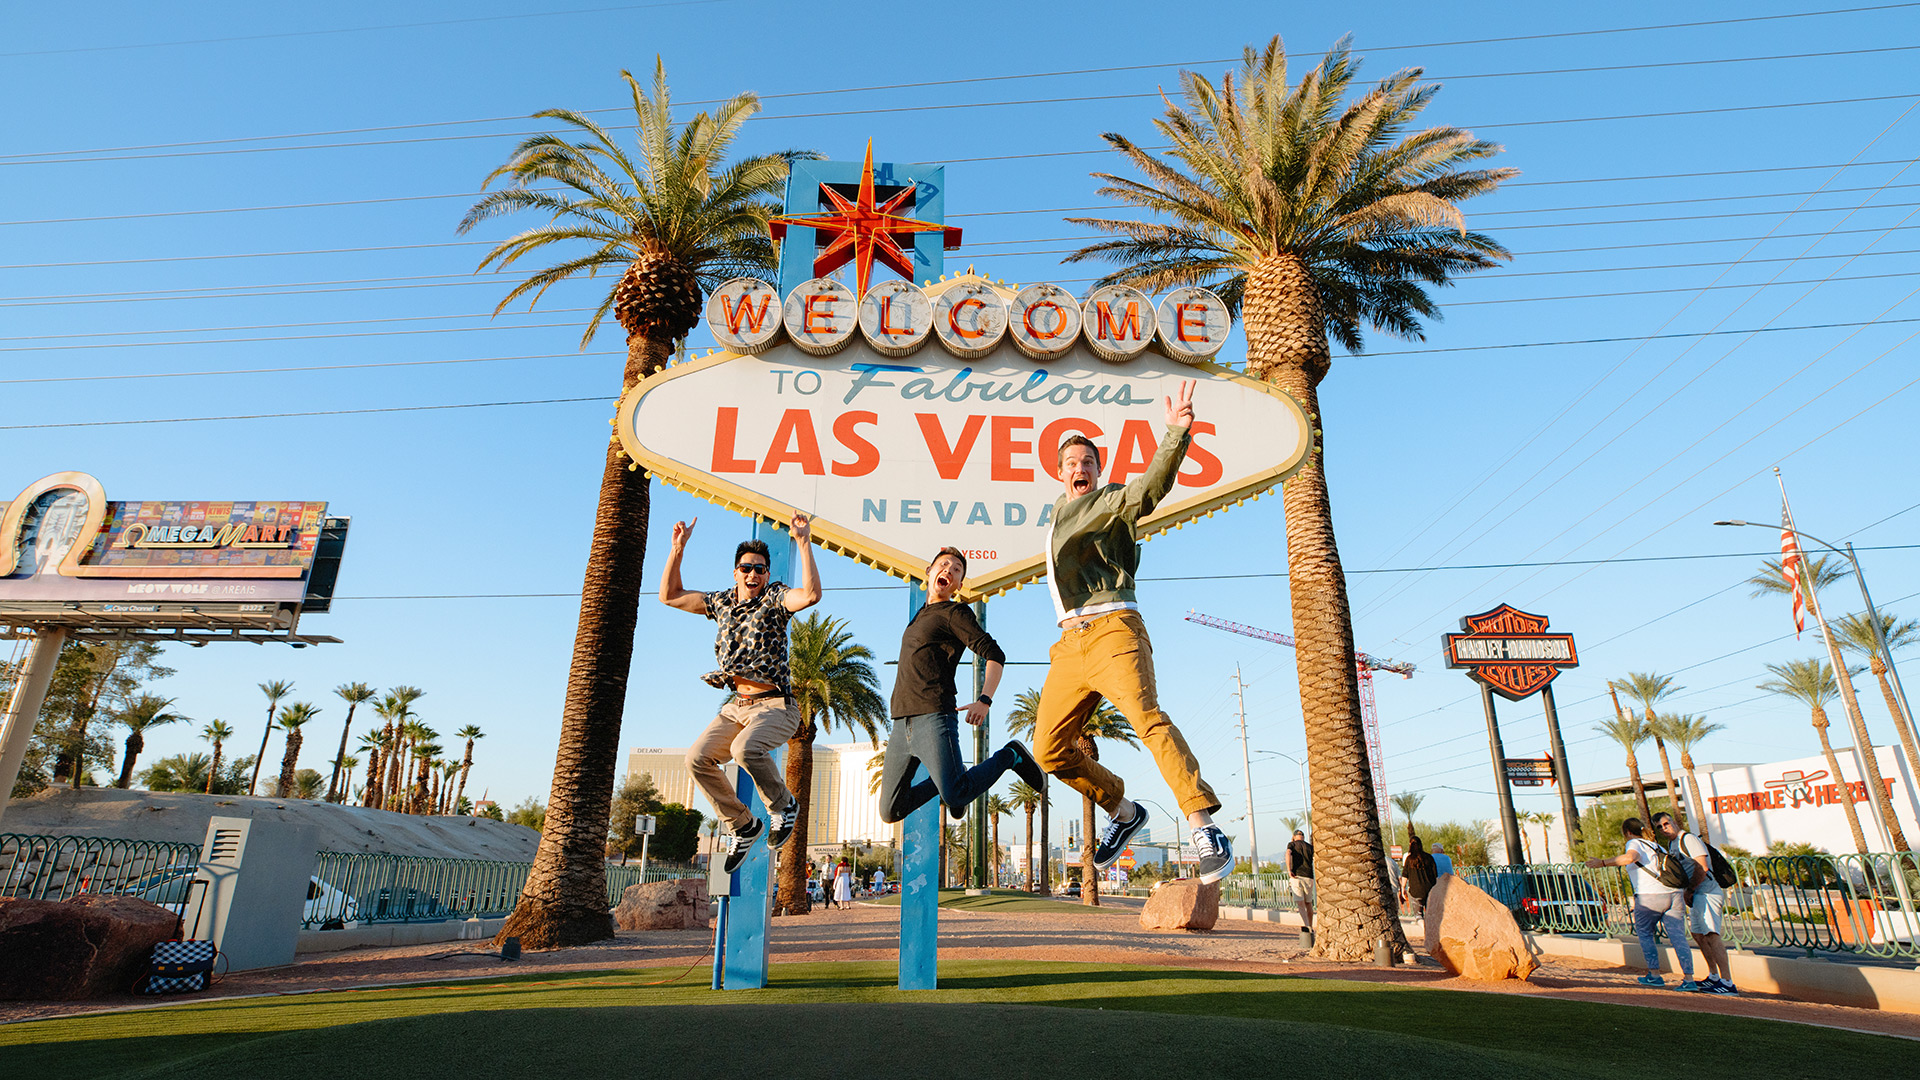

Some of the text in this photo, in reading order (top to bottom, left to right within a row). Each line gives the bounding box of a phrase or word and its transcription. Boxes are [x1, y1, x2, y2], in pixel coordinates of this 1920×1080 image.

[721, 293, 1209, 342] WELCOME
[770, 362, 1155, 406] TO Fabulous
[710, 407, 1224, 488] LAS VEGAS
[962, 549, 998, 560] YESCO
[127, 584, 169, 594] MEOW
[170, 584, 208, 594] WOLF
[1478, 611, 1540, 633] MOTOR
[1455, 639, 1572, 660] HARLEY-DAVIDSON
[1486, 665, 1549, 691] CYCLES
[1707, 777, 1896, 815] TERRIBLE HERBT
